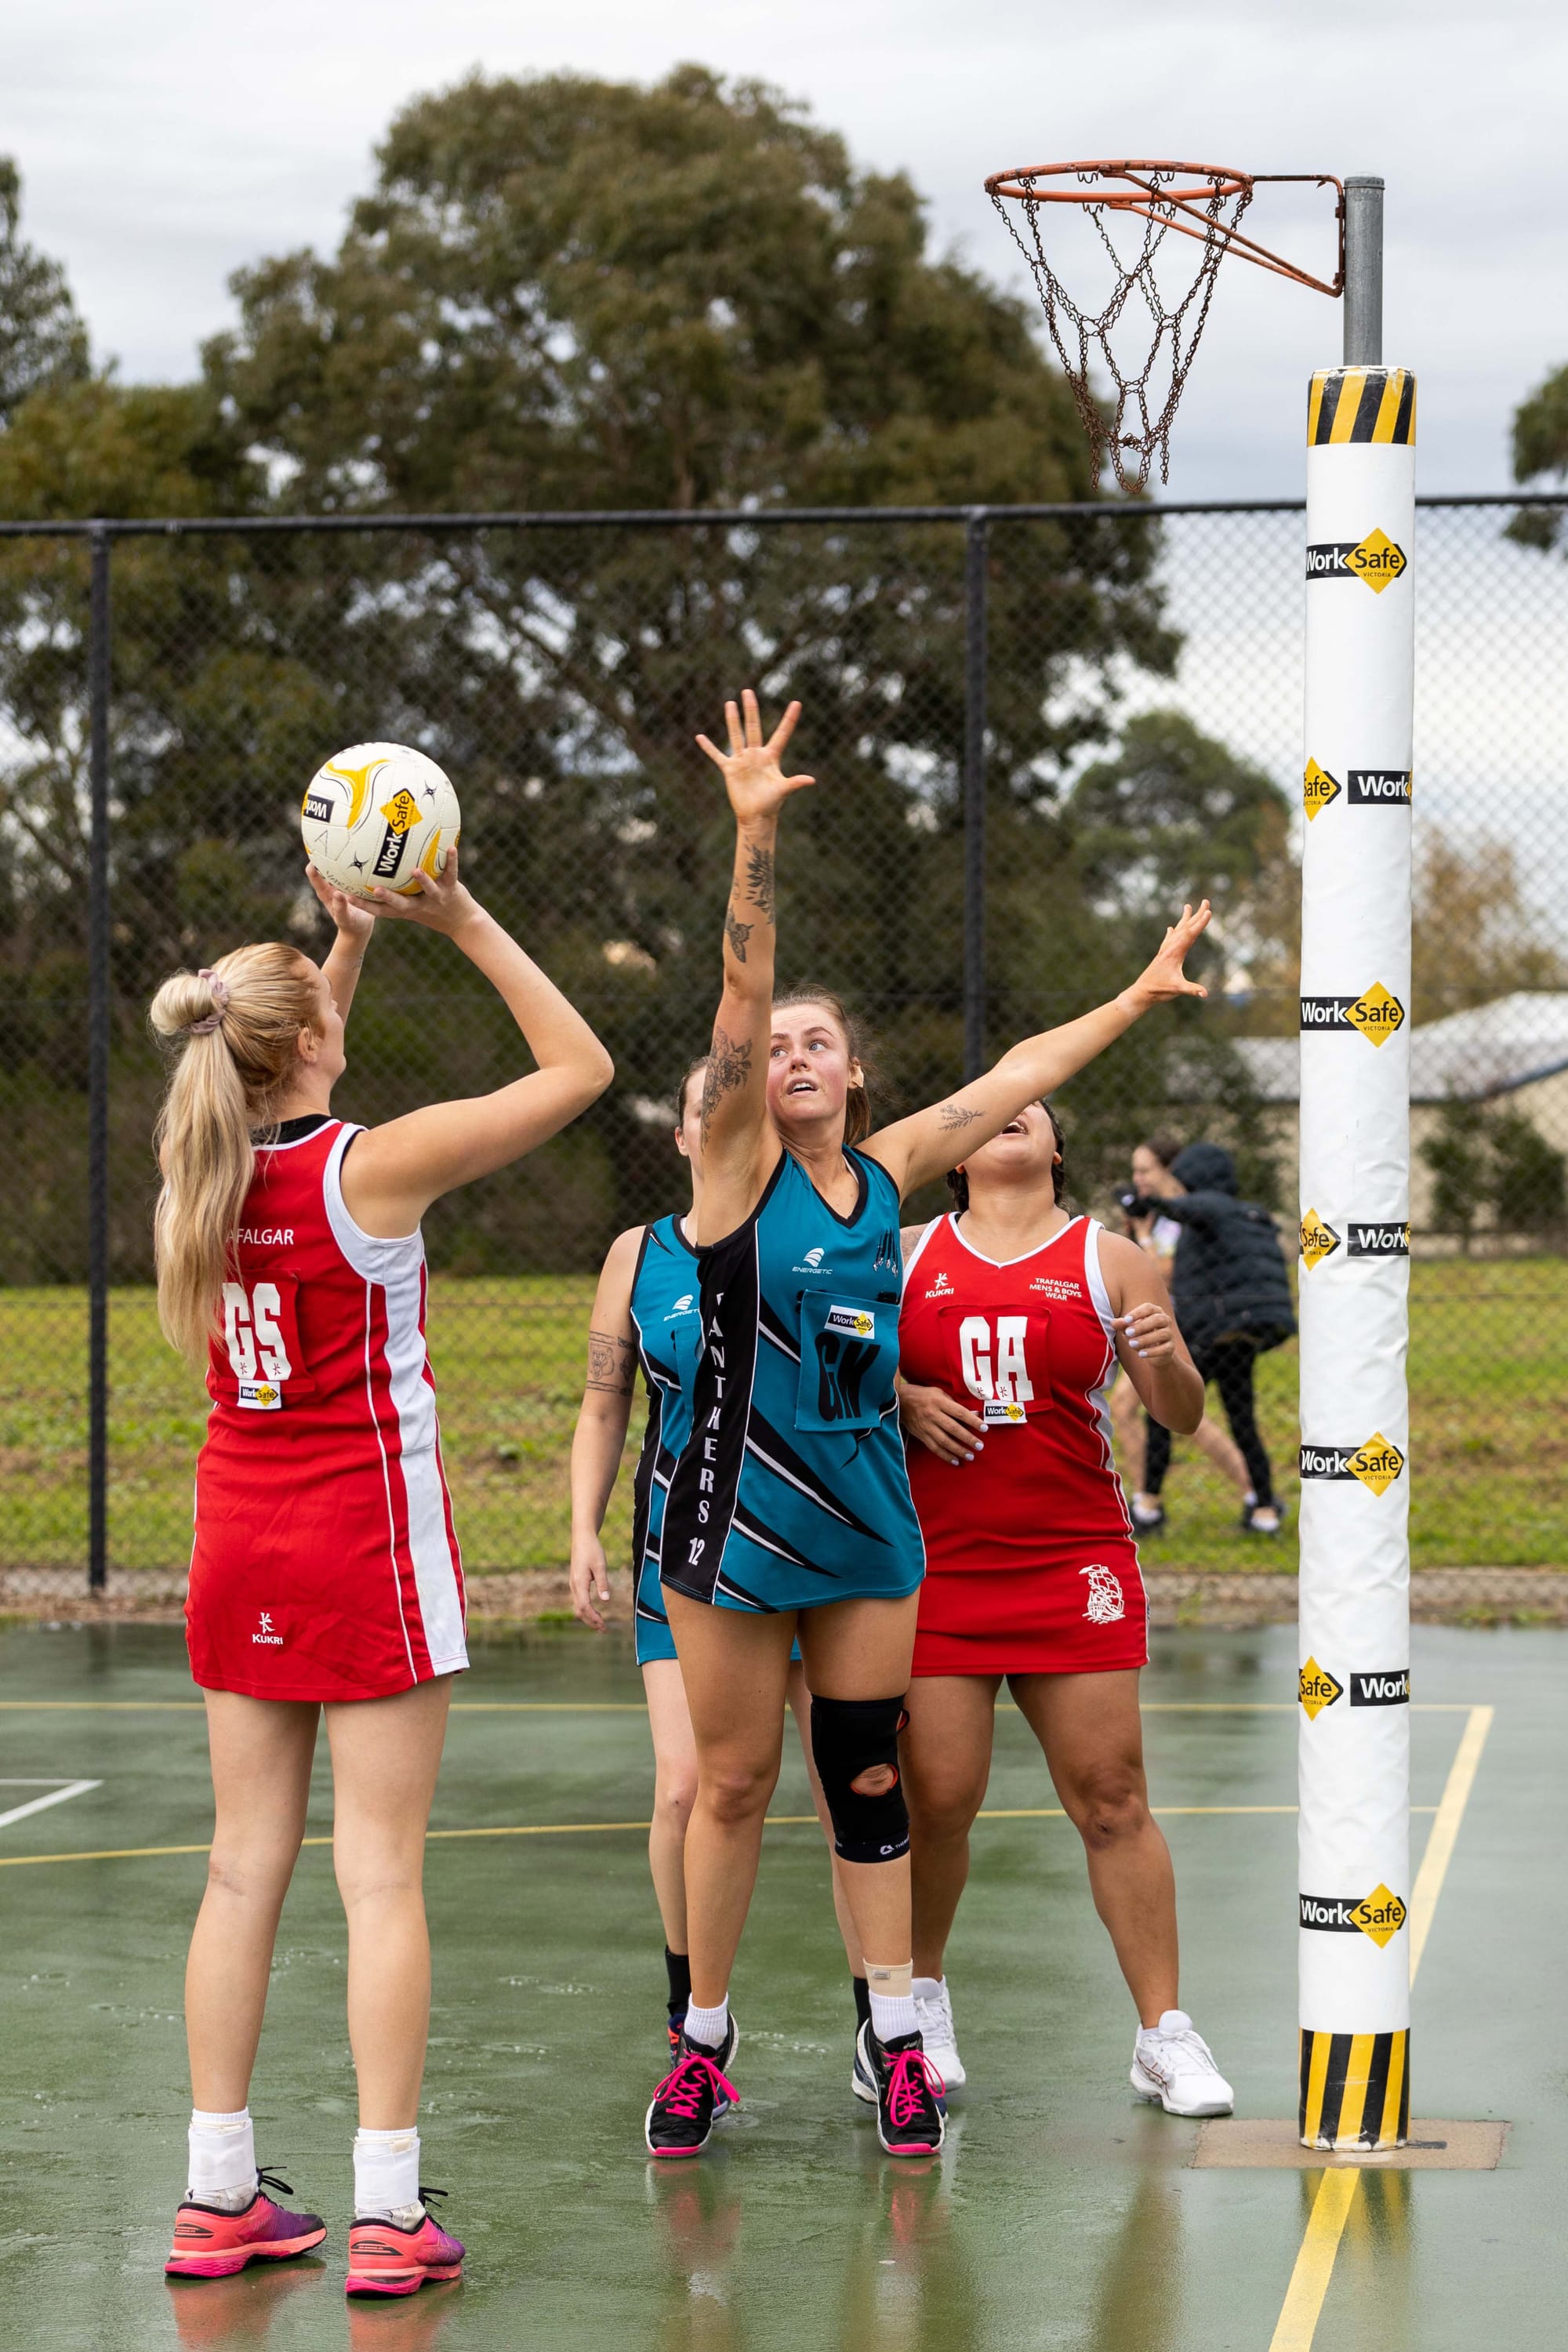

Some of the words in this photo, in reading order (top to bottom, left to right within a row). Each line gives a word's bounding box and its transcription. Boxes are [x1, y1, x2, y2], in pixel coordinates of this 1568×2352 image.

[1029, 1283, 1053, 1292] MENS
[1061, 1287, 1083, 1298] BOYS
[1035, 1277, 1080, 1290] TRAFALGAR
[925, 1287, 955, 1299] KUKRI
[1045, 1291, 1068, 1301] WEAR
[222, 1282, 292, 1381] GS
[959, 1316, 1035, 1403] GA
[687, 1537, 706, 1566] 12
[252, 1634, 284, 1646] KUKRI
